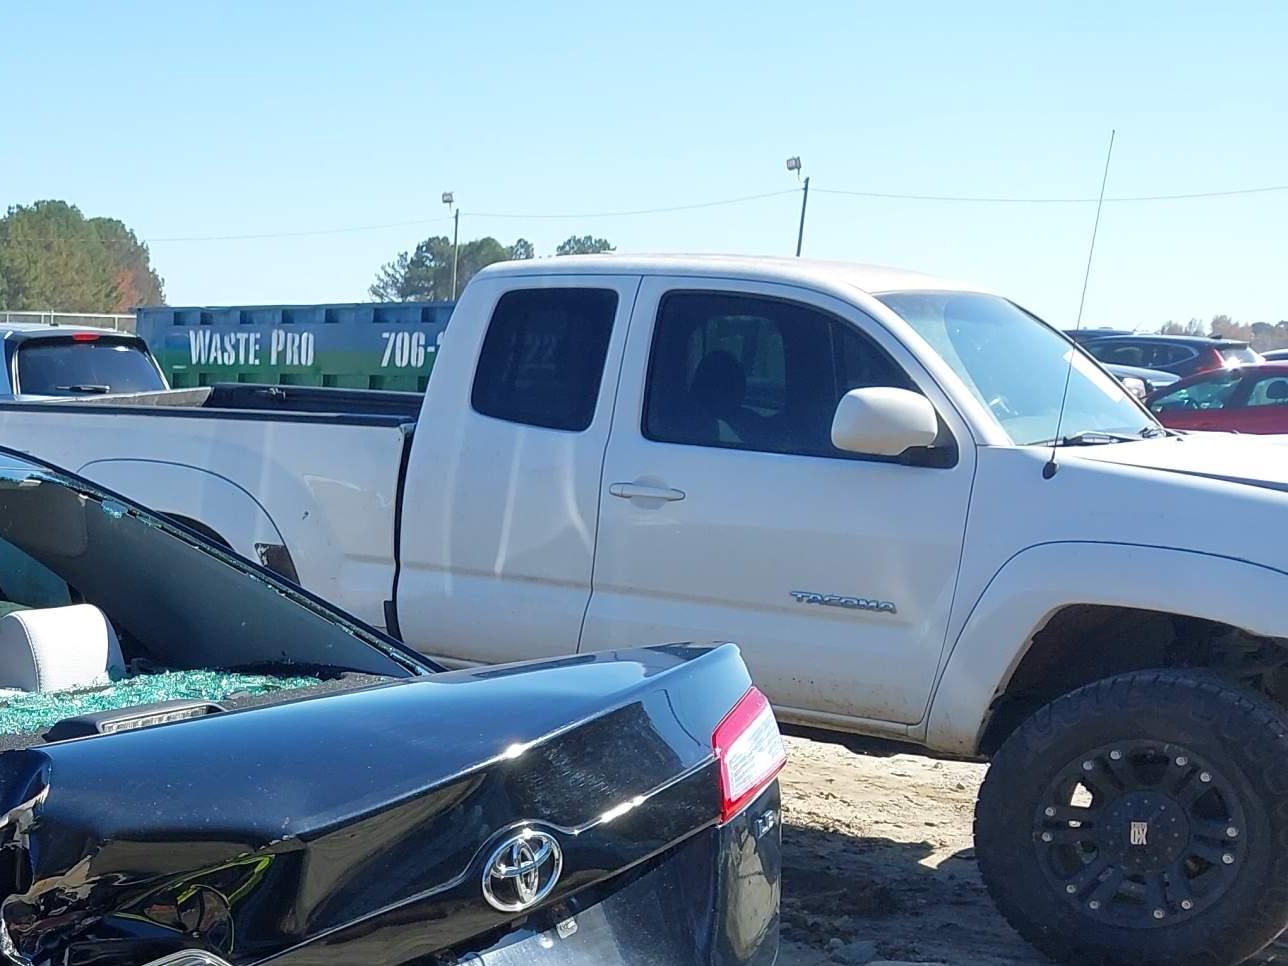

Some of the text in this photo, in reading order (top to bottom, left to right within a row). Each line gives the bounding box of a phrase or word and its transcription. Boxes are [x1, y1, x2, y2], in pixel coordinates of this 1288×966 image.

[189, 329, 261, 365] WASTE
[270, 329, 314, 366] PRO
[790, 590, 897, 614] TACOMA
